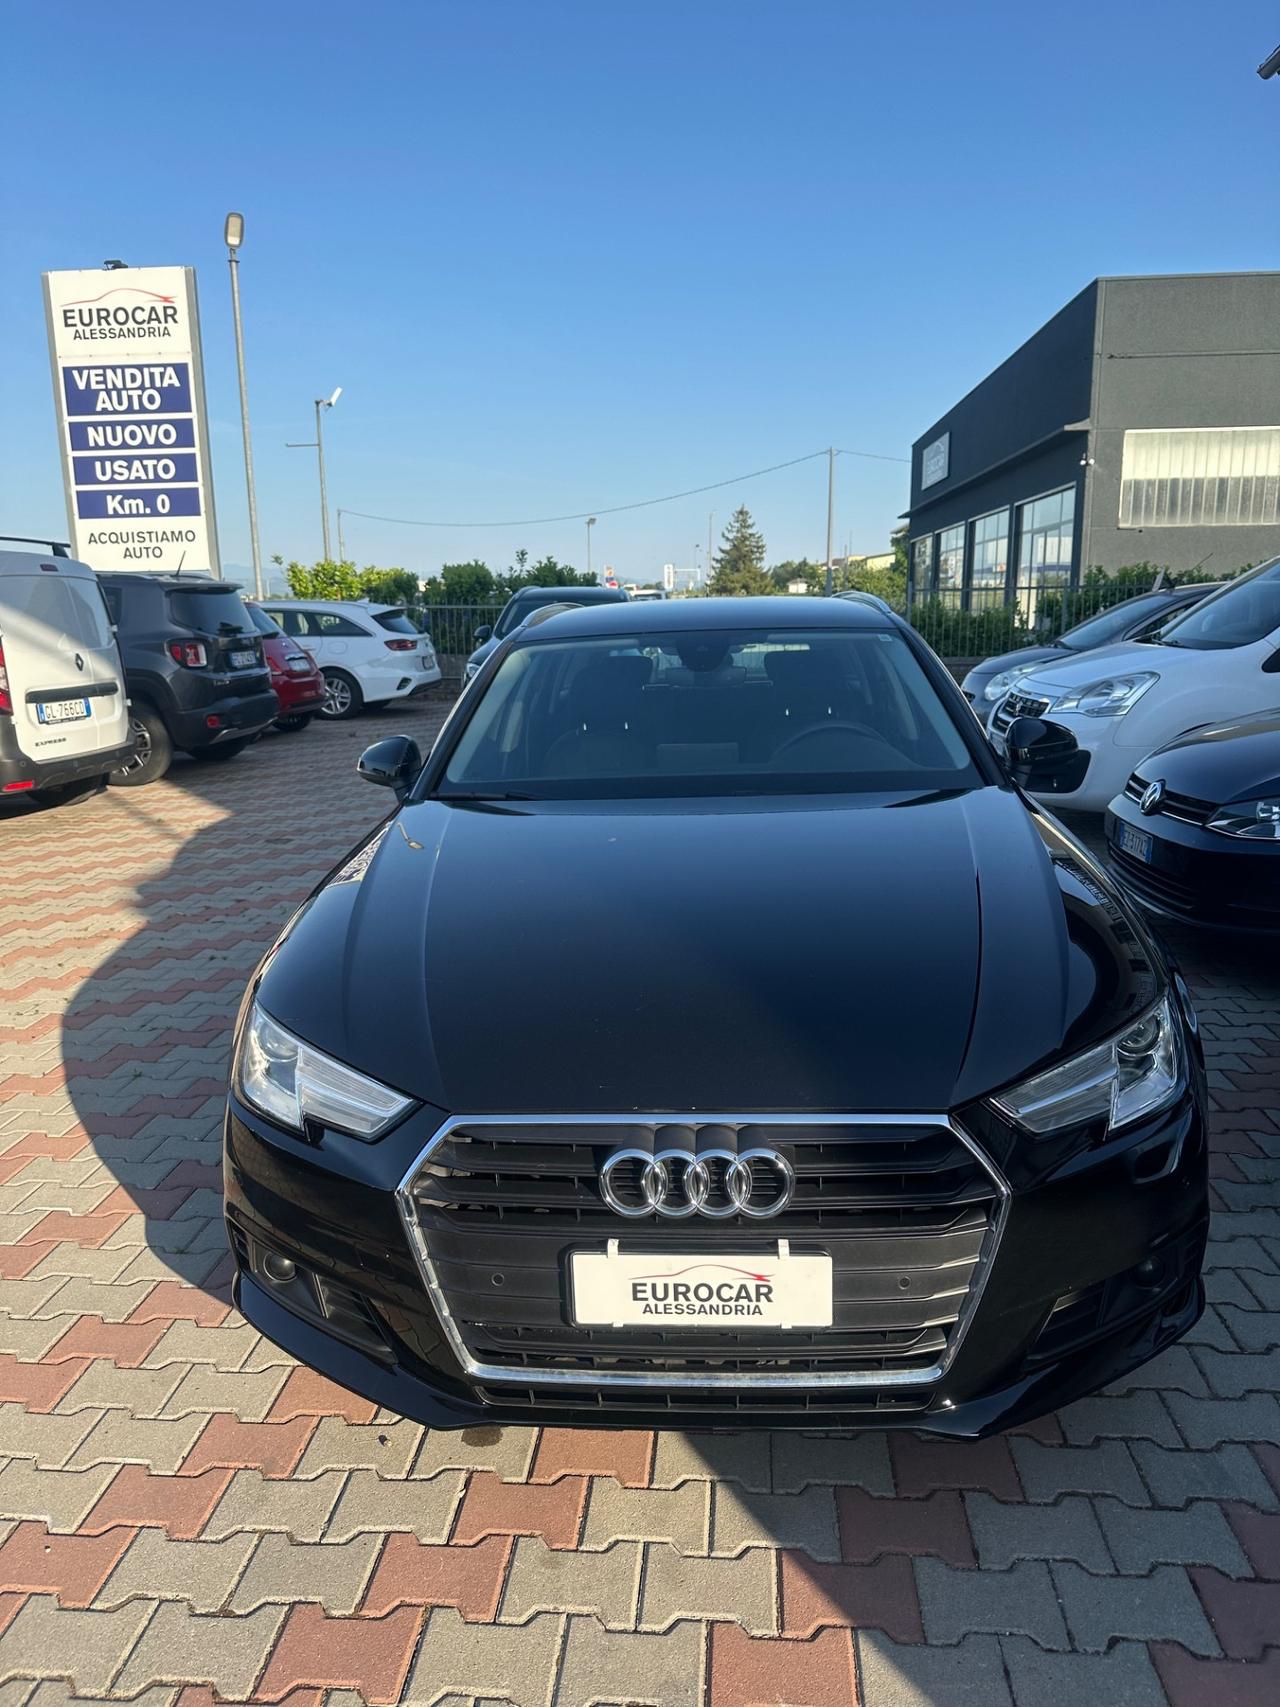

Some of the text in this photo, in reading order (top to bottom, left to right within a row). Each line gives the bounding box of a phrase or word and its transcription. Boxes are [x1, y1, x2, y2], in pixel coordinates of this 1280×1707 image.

[62, 305, 179, 328] EUROCAR
[73, 326, 171, 341] ALESSANDRIA
[72, 366, 180, 390] VENDITA
[96, 389, 162, 412] AUTO
[87, 423, 178, 447] NUOVO
[95, 458, 177, 482] USATO
[106, 493, 170, 515] Km. 0
[88, 530, 196, 545] ACQUISTIAMO
[123, 546, 163, 560] AUTO
[631, 1282, 774, 1303] EUROCAR
[642, 1303, 763, 1316] ALESSANDRIA
